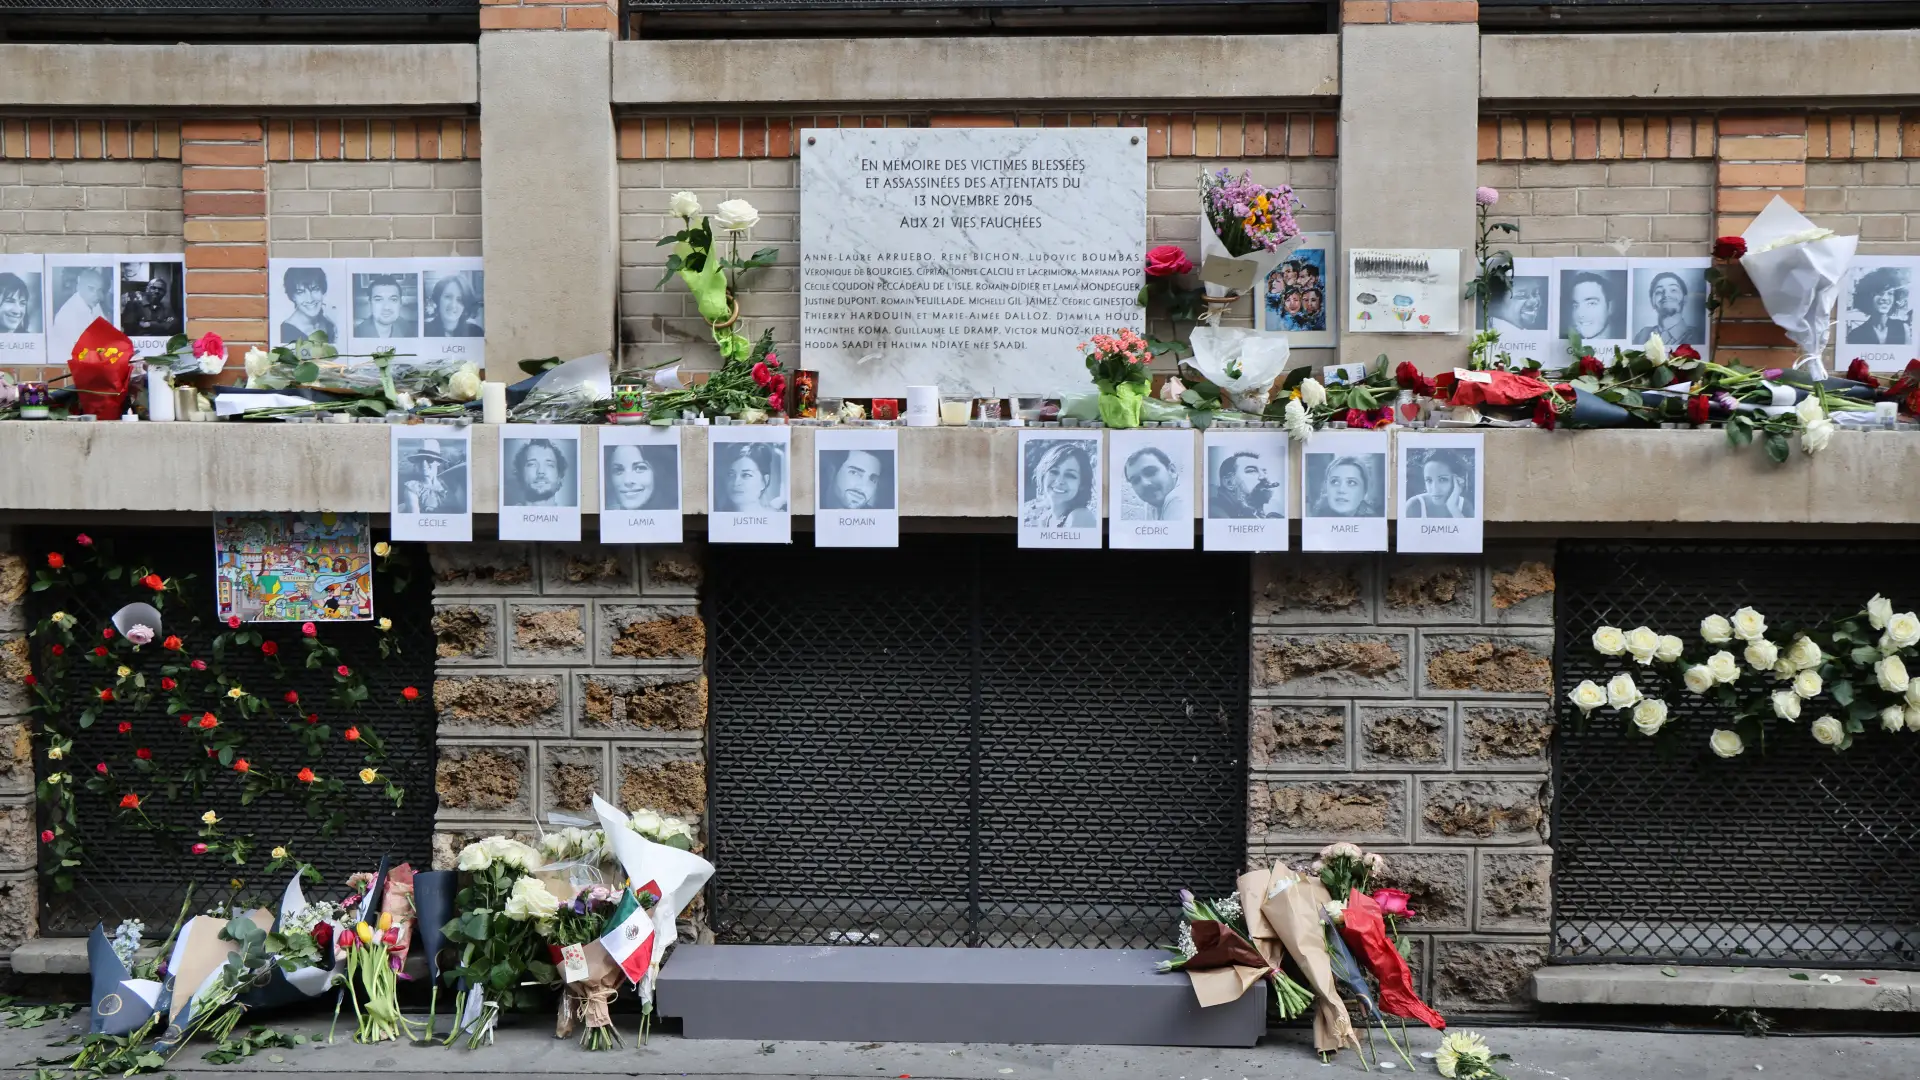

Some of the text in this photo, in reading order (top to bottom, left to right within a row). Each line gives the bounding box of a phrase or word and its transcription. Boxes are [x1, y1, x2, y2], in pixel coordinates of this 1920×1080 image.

[862, 156, 1086, 170] EN MÉMOIRE DES VICTIMES BLESSÉES
[865, 175, 1080, 189] ET ASSASSINÉES DES ATTENTATS DU
[914, 195, 1033, 207] 13 NOVEMBRE 2015
[900, 214, 1042, 228] AUX 21 VIES FAUCHÉES
[804, 253, 872, 261] ANNE-LAURE
[1029, 253, 1077, 261] LUDOVIC
[854, 268, 864, 276] DE
[917, 268, 948, 276] CIPRIAN
[952, 268, 977, 276] IONUT
[980, 268, 1014, 276] CALCIU
[1016, 268, 1025, 276] ET
[832, 282, 874, 291] COUDON
[877, 282, 930, 291] PECCADEAU
[933, 283, 944, 291] DE
[976, 283, 1008, 291] ROMAIN
[1012, 283, 1040, 291] DIDIER
[1042, 283, 1051, 291] ET
[1054, 283, 1078, 291] LAMIA
[804, 297, 836, 305] JUSTINE
[880, 297, 914, 305] ROMAIN
[968, 297, 1006, 305] MICHELLI
[1008, 297, 1022, 305] GIL
[804, 312, 846, 320] THIERRY
[850, 312, 912, 320] HARDOUIN
[917, 312, 927, 320] ET
[1056, 312, 1100, 320] DJAMILA
[804, 326, 855, 334] HYACINTHE
[894, 326, 946, 334] GUILLAUME
[950, 326, 960, 334] LE
[1004, 326, 1038, 335] VICTOR
[441, 344, 466, 354] LACRI
[804, 341, 838, 349] HODDA
[842, 341, 873, 349] SAADI
[877, 341, 888, 349] ET
[891, 341, 928, 349] HALIMA
[932, 341, 970, 349] NDIAYE
[1860, 352, 1895, 361] HODDA
[418, 518, 447, 527] CÉCILE
[523, 514, 558, 523] ROMAIN
[628, 518, 656, 527] LAMIA
[733, 516, 768, 526] JUSTINE
[839, 518, 876, 527] ROMAIN
[1135, 526, 1169, 536] CÉDRIC
[1228, 524, 1265, 534] THIERRY
[1331, 524, 1359, 533] MARIE
[1421, 524, 1459, 534] DJAMILA
[1040, 531, 1081, 540] MICHELLI
